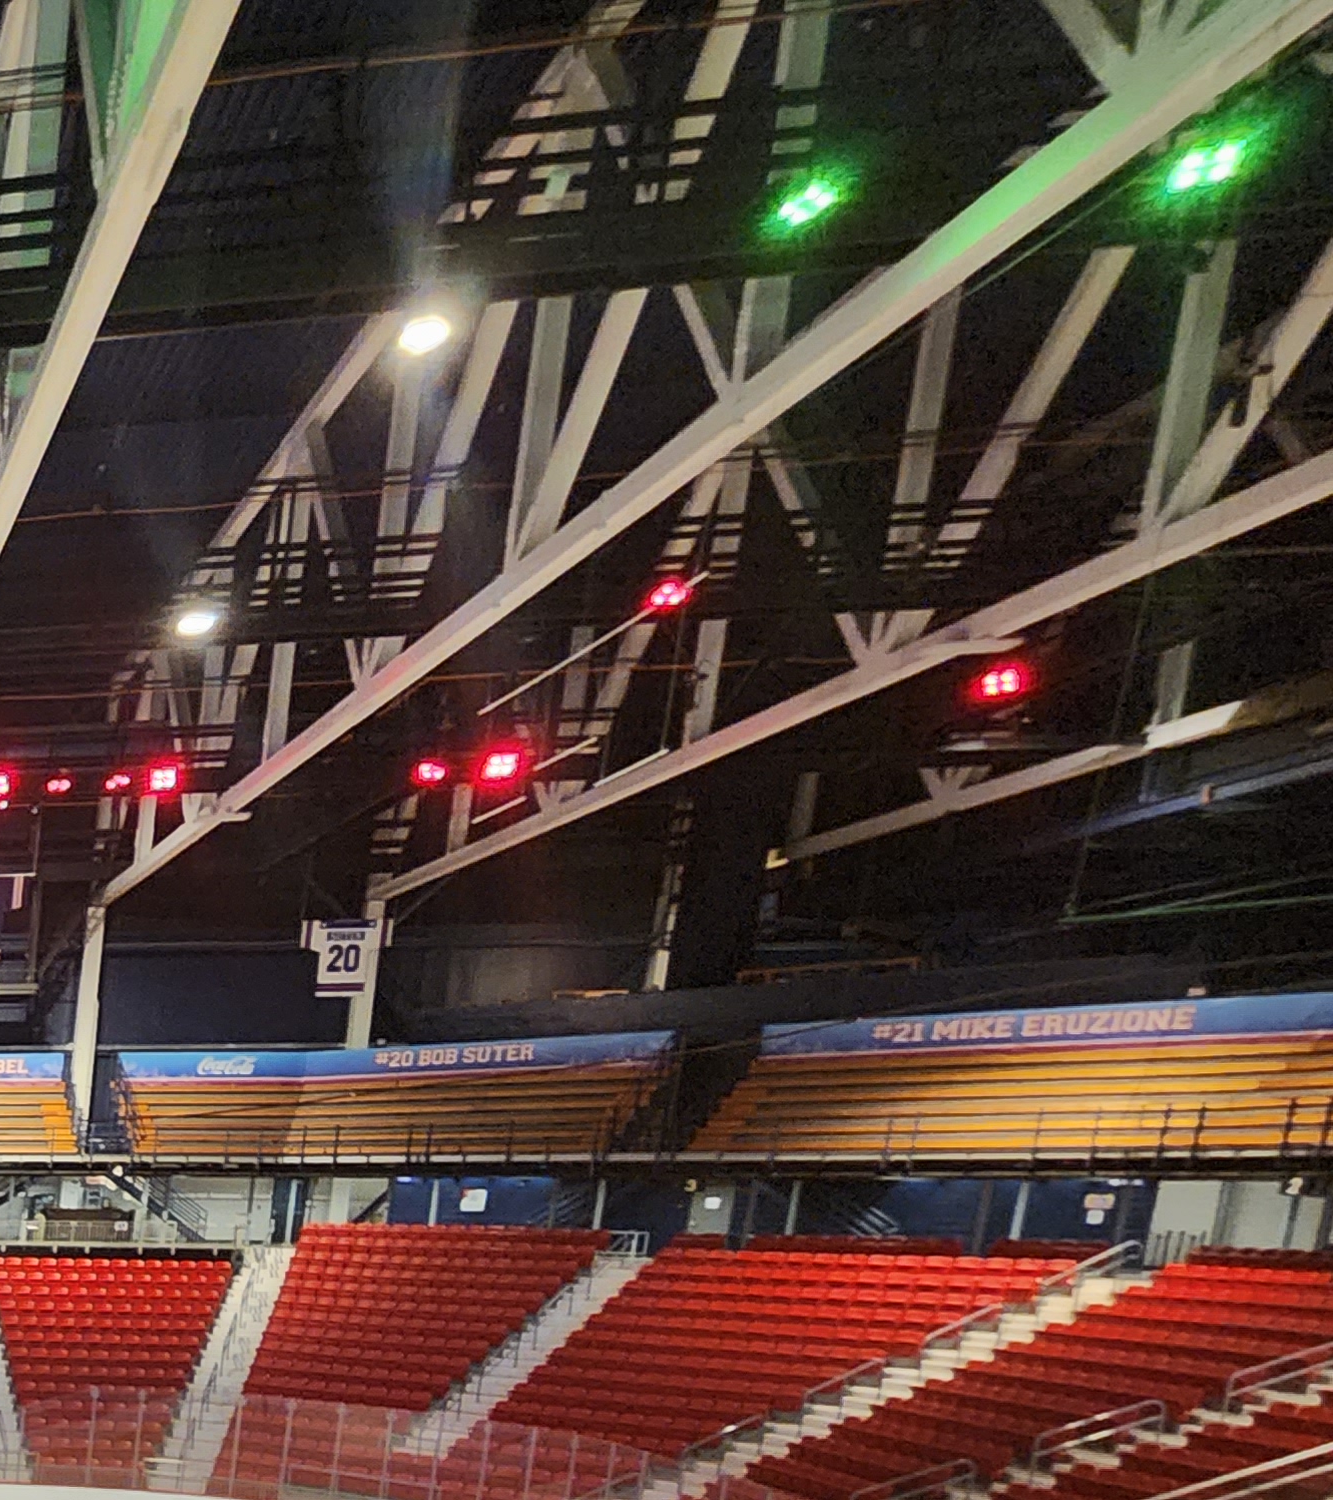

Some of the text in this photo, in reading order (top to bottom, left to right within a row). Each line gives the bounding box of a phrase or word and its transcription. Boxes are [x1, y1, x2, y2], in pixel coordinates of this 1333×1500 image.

[327, 944, 361, 973] 20
[873, 1005, 1197, 1043] #21 MIKE ERUZIONE
[374, 1043, 535, 1067] #20 BOB SUTER
